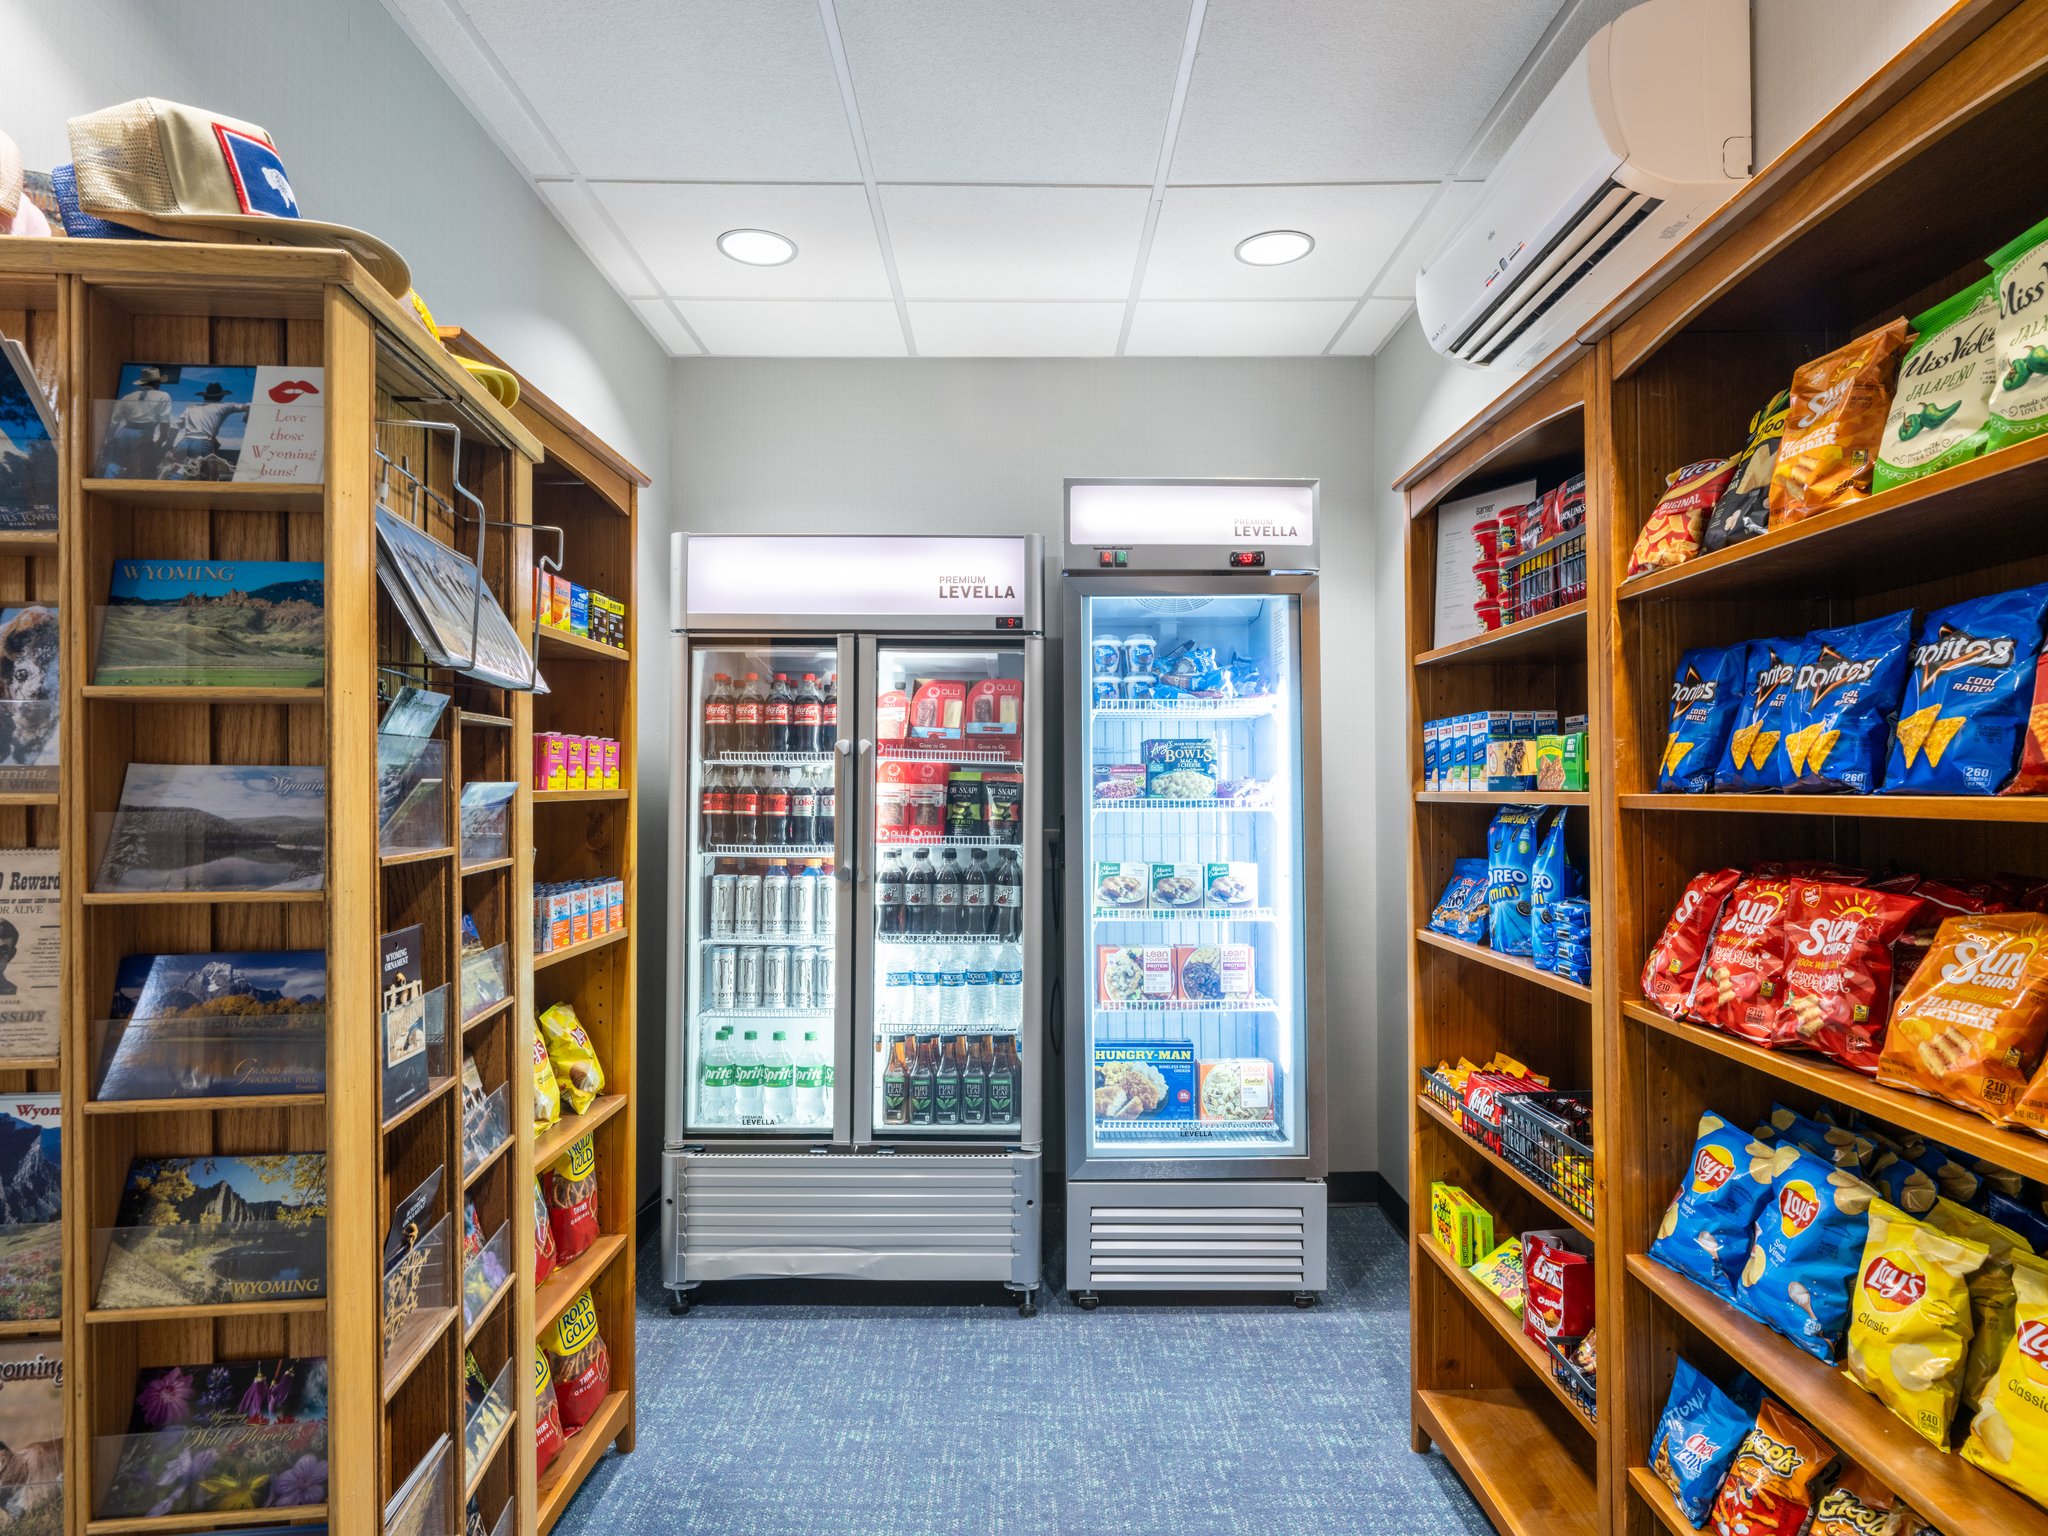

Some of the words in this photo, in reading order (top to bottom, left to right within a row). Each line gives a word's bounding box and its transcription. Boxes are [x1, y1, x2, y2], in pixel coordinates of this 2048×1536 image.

[1899, 350, 1951, 381] Miss
[1950, 322, 1996, 364] Vickie
[1906, 361, 1976, 402] JALAPEÑO
[2019, 397, 2040, 410] made
[274, 409, 307, 423] Love
[269, 428, 304, 441] those
[251, 444, 318, 463] Wyoming
[1779, 434, 1838, 462] CHEDDAR
[260, 465, 298, 478] buns!
[20, 509, 58, 522] TOWER
[1234, 526, 1298, 537] LEVELLA
[123, 564, 236, 582] WYOMING
[939, 575, 986, 584] PREMIUM
[939, 585, 1015, 599] LEVELLA
[1007, 618, 1015, 628] 9
[1914, 635, 2014, 668] Doritos
[1795, 656, 1878, 690] Doritos
[1965, 675, 1996, 686] COOL
[941, 688, 961, 696] OLLI
[996, 683, 1016, 692] OLLI
[1952, 682, 1996, 693] RANCH
[1689, 708, 1707, 716] COOL
[1151, 740, 1174, 757] Amy's
[1164, 749, 1213, 763] BOWLS
[1844, 773, 1863, 783] 260
[1965, 766, 1990, 778] 260
[997, 787, 1017, 796] SNAP!
[9, 871, 61, 891] Reward
[1488, 869, 1527, 884] OREO
[1490, 884, 1519, 900] mini
[12, 905, 44, 914] ALIVE
[1734, 920, 1767, 935] CHIPS
[1798, 917, 1859, 957] Sun
[385, 947, 408, 963] WYOMING
[1145, 950, 1168, 958] Lean
[1821, 942, 1852, 956] CHIPS
[384, 955, 409, 972] ORNAMENT
[1941, 939, 2027, 986] Sun
[1657, 980, 1672, 994] 210
[1971, 973, 2020, 991] CHIPS
[1747, 1007, 1764, 1018] 210
[1923, 994, 2003, 1019] HARVEST
[1095, 1050, 1191, 1061] HUNGRY-MAN
[764, 1067, 794, 1082] Sprite
[1985, 1078, 2007, 1092] 210
[573, 1146, 594, 1171] GOLD
[1695, 1149, 1730, 1183] Lay's
[1783, 1191, 1817, 1226] Lay's
[1503, 1254, 1523, 1273] SOU
[1866, 1258, 1926, 1299] Lay's
[231, 1278, 320, 1297] WYOMING
[562, 1295, 591, 1329] ROLD
[564, 1310, 596, 1344] GOLD
[1858, 1311, 1890, 1337] Classic
[578, 1367, 596, 1386] THINS
[573, 1375, 600, 1397] ORIGINAL
[1919, 1409, 1939, 1427] 240
[1686, 1433, 1719, 1459] Chex
